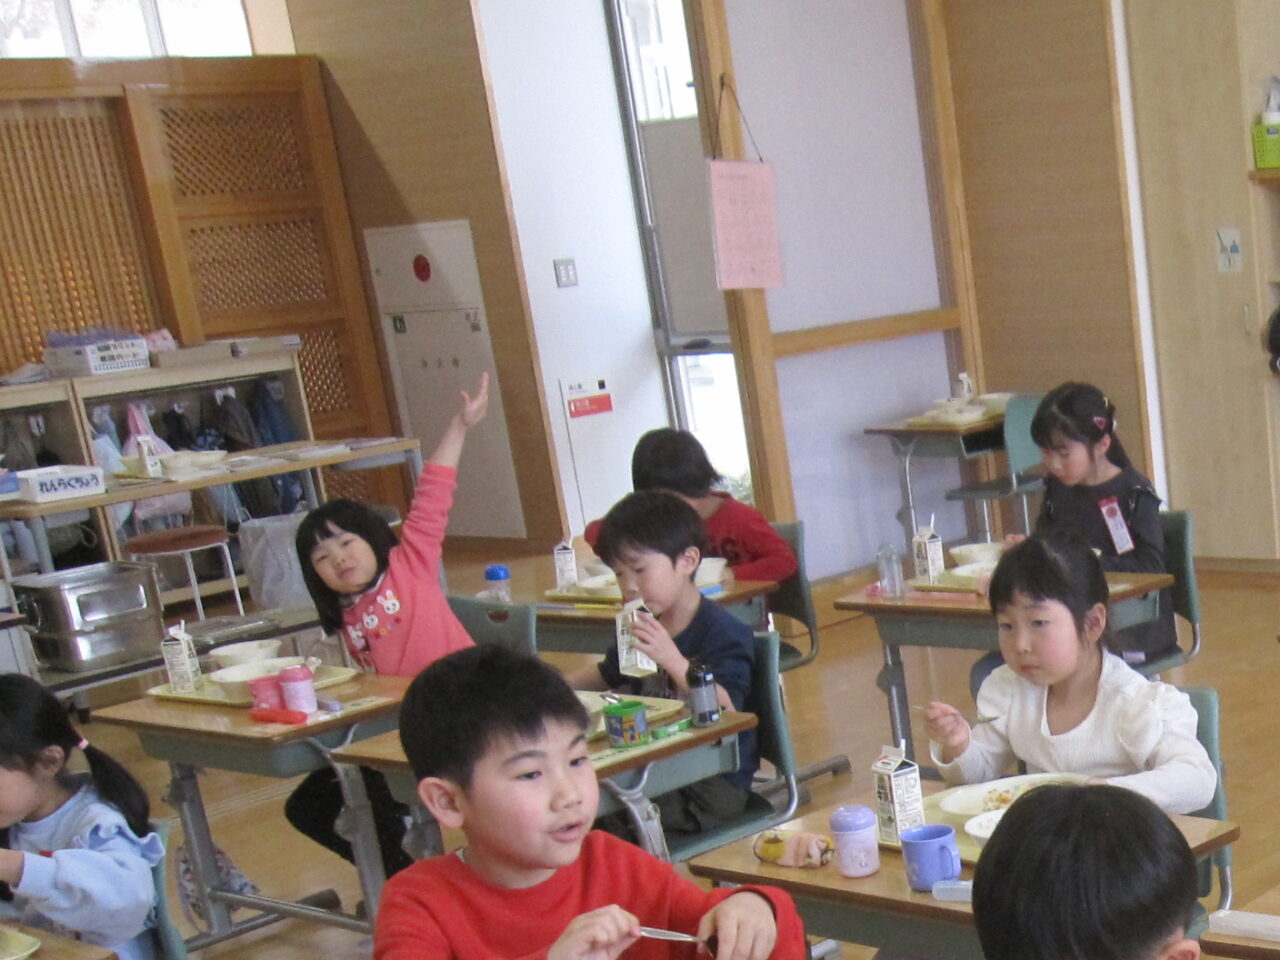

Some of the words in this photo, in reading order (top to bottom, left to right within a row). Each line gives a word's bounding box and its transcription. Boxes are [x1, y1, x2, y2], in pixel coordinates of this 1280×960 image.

[41, 475, 98, 492] れんらくちょう
